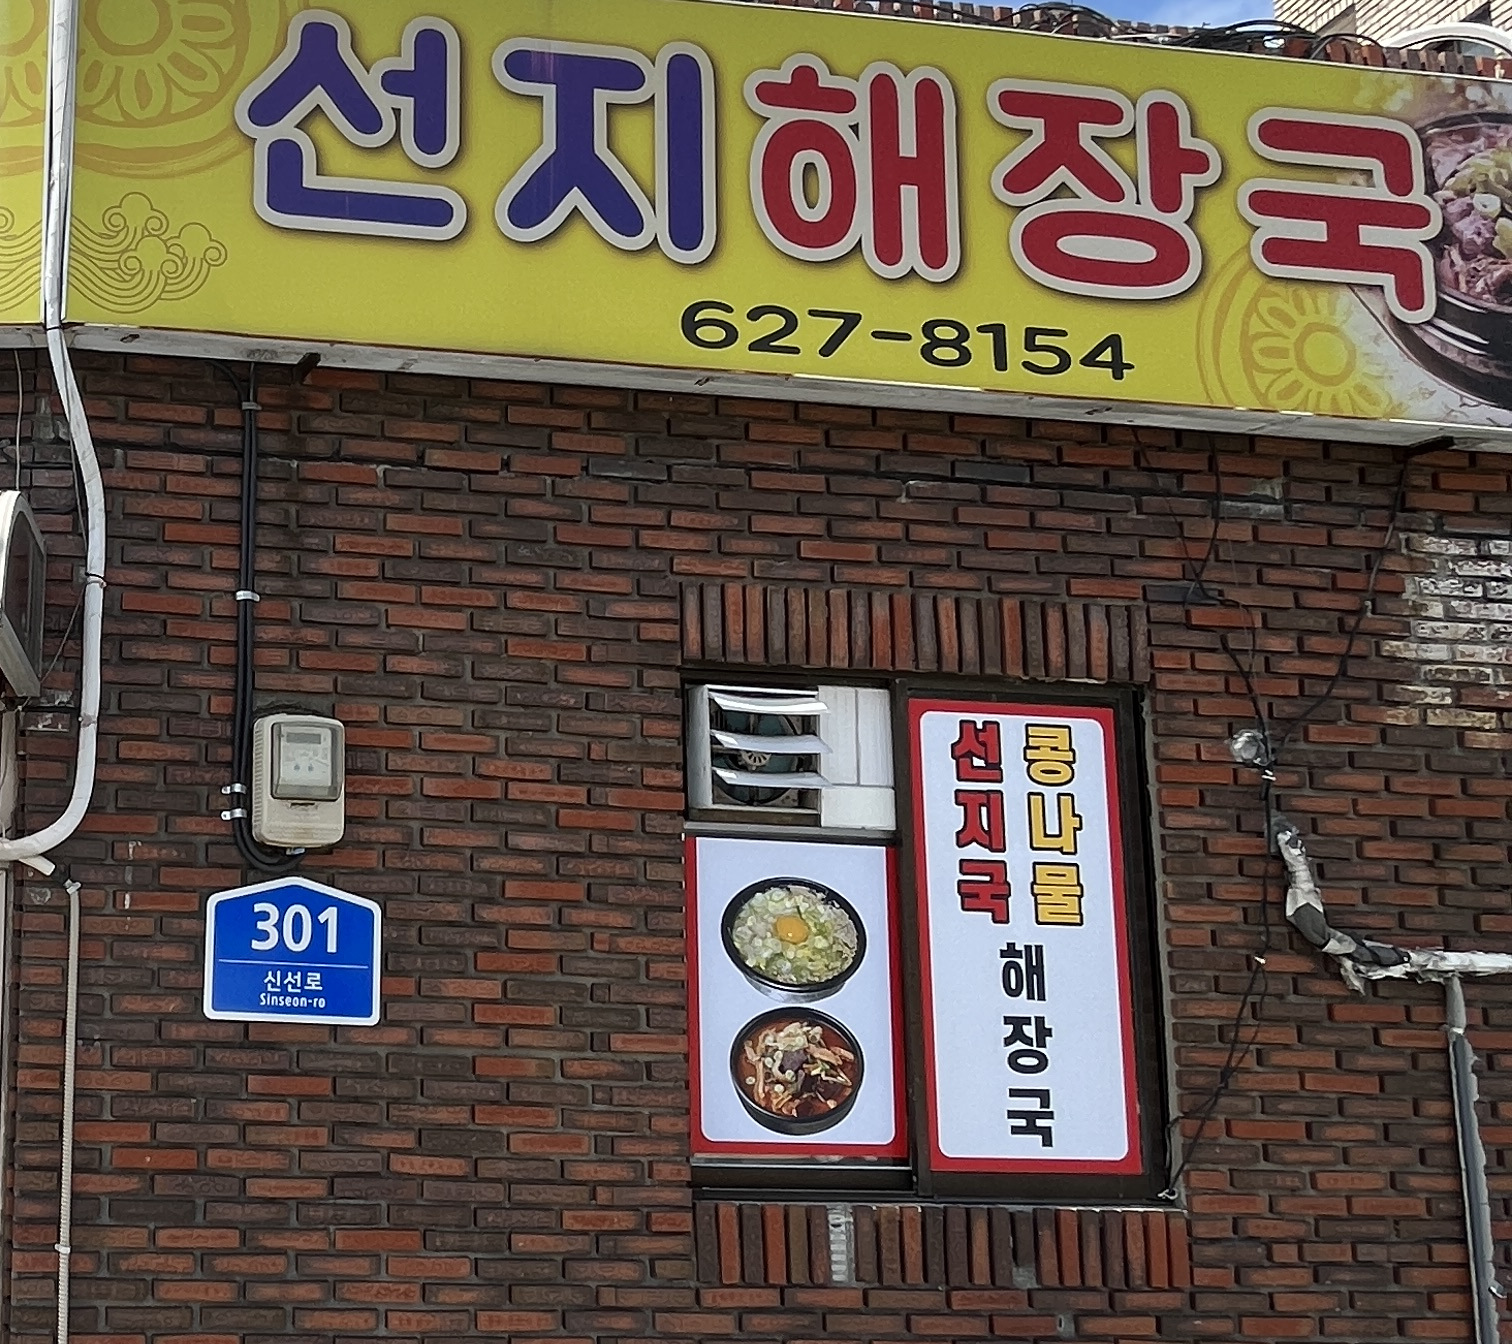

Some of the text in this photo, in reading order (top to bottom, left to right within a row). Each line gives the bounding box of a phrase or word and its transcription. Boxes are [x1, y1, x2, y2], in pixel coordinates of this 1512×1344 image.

[236, 8, 1443, 323] 선지해장국
[680, 300, 1136, 382] 627-8154
[950, 719, 1010, 925] 선지국
[1024, 722, 1083, 926] 콩나물
[251, 903, 339, 954] 301
[263, 970, 324, 994] 신선로
[259, 992, 326, 1009] Sinseon-ro
[999, 941, 1054, 1148] 해장국
